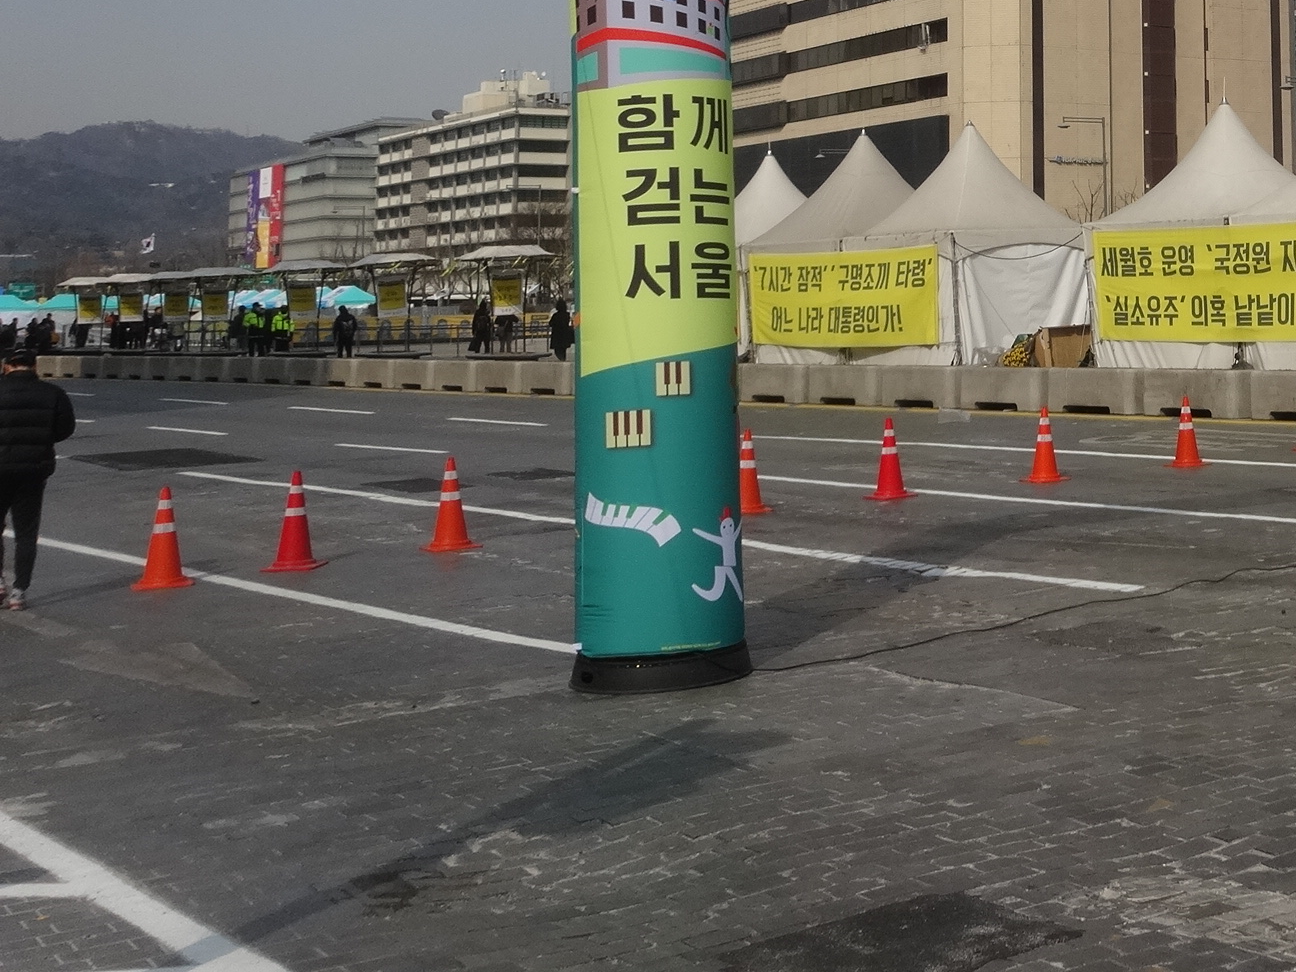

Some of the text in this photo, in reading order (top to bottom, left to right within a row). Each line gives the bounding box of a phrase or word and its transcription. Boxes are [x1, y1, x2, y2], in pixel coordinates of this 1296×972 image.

[617, 93, 729, 155] 함께
[621, 166, 730, 226] 걷는
[625, 240, 732, 300] 서울
[1101, 245, 1154, 278] 세월호
[1160, 244, 1195, 277] 운영
[771, 304, 904, 334] 어느 나라 대통령인가!
[1191, 294, 1226, 327] 의혹
[1233, 292, 1295, 327] 낱낱이
